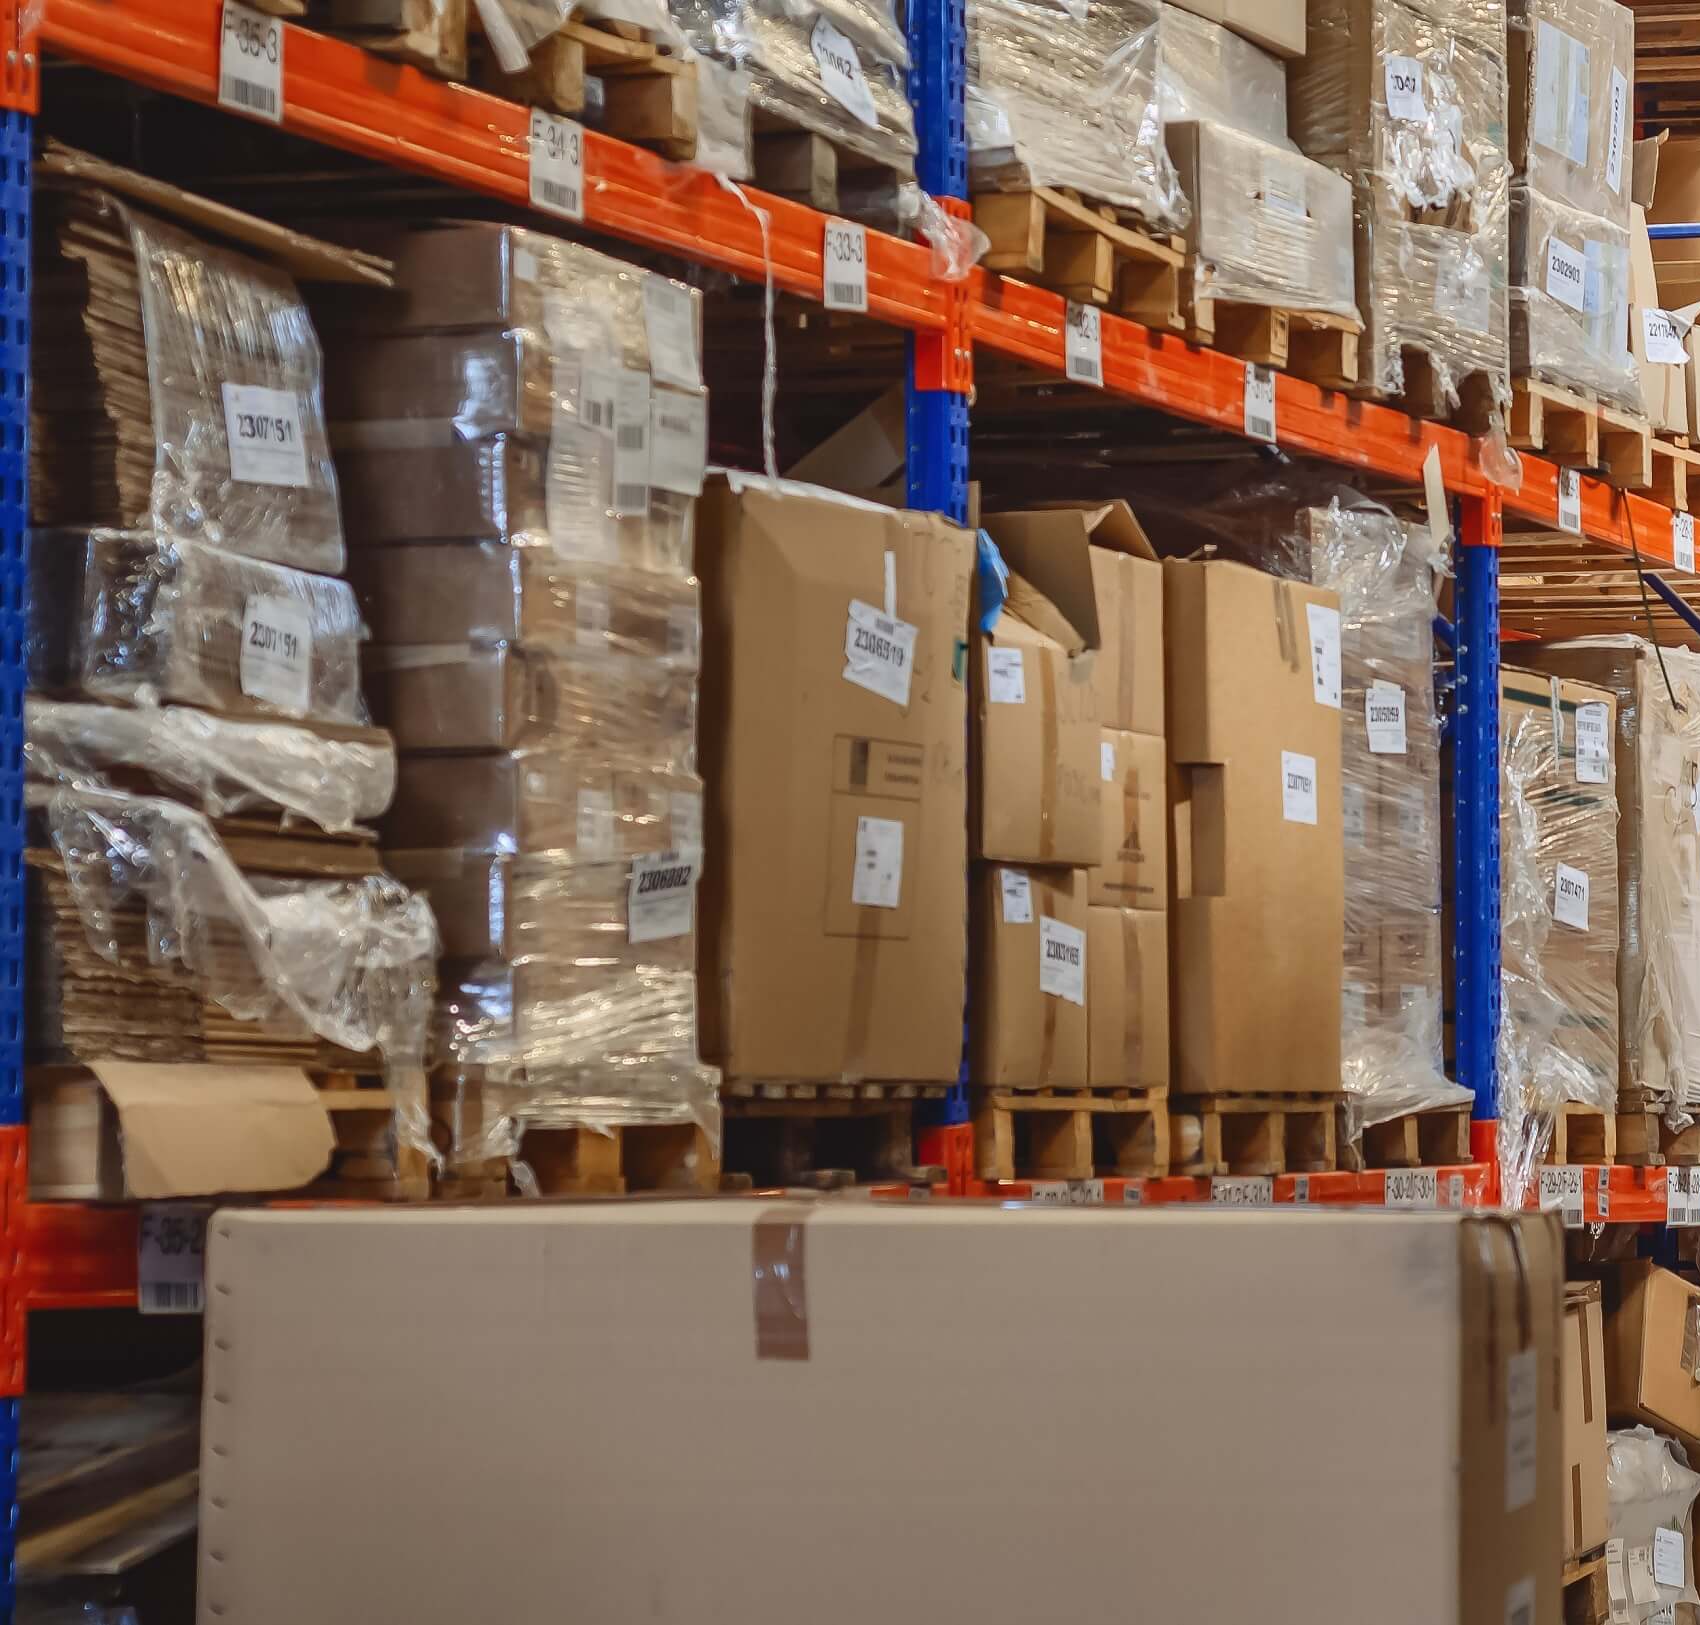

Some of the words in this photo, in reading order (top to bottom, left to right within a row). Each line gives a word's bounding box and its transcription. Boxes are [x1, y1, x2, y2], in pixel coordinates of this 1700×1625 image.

[223, 11, 279, 66] F-35-3
[825, 229, 863, 266] F-33-3
[1551, 255, 1581, 284] 2302903
[238, 414, 295, 443] 2307151
[1559, 876, 1586, 903] 2307471
